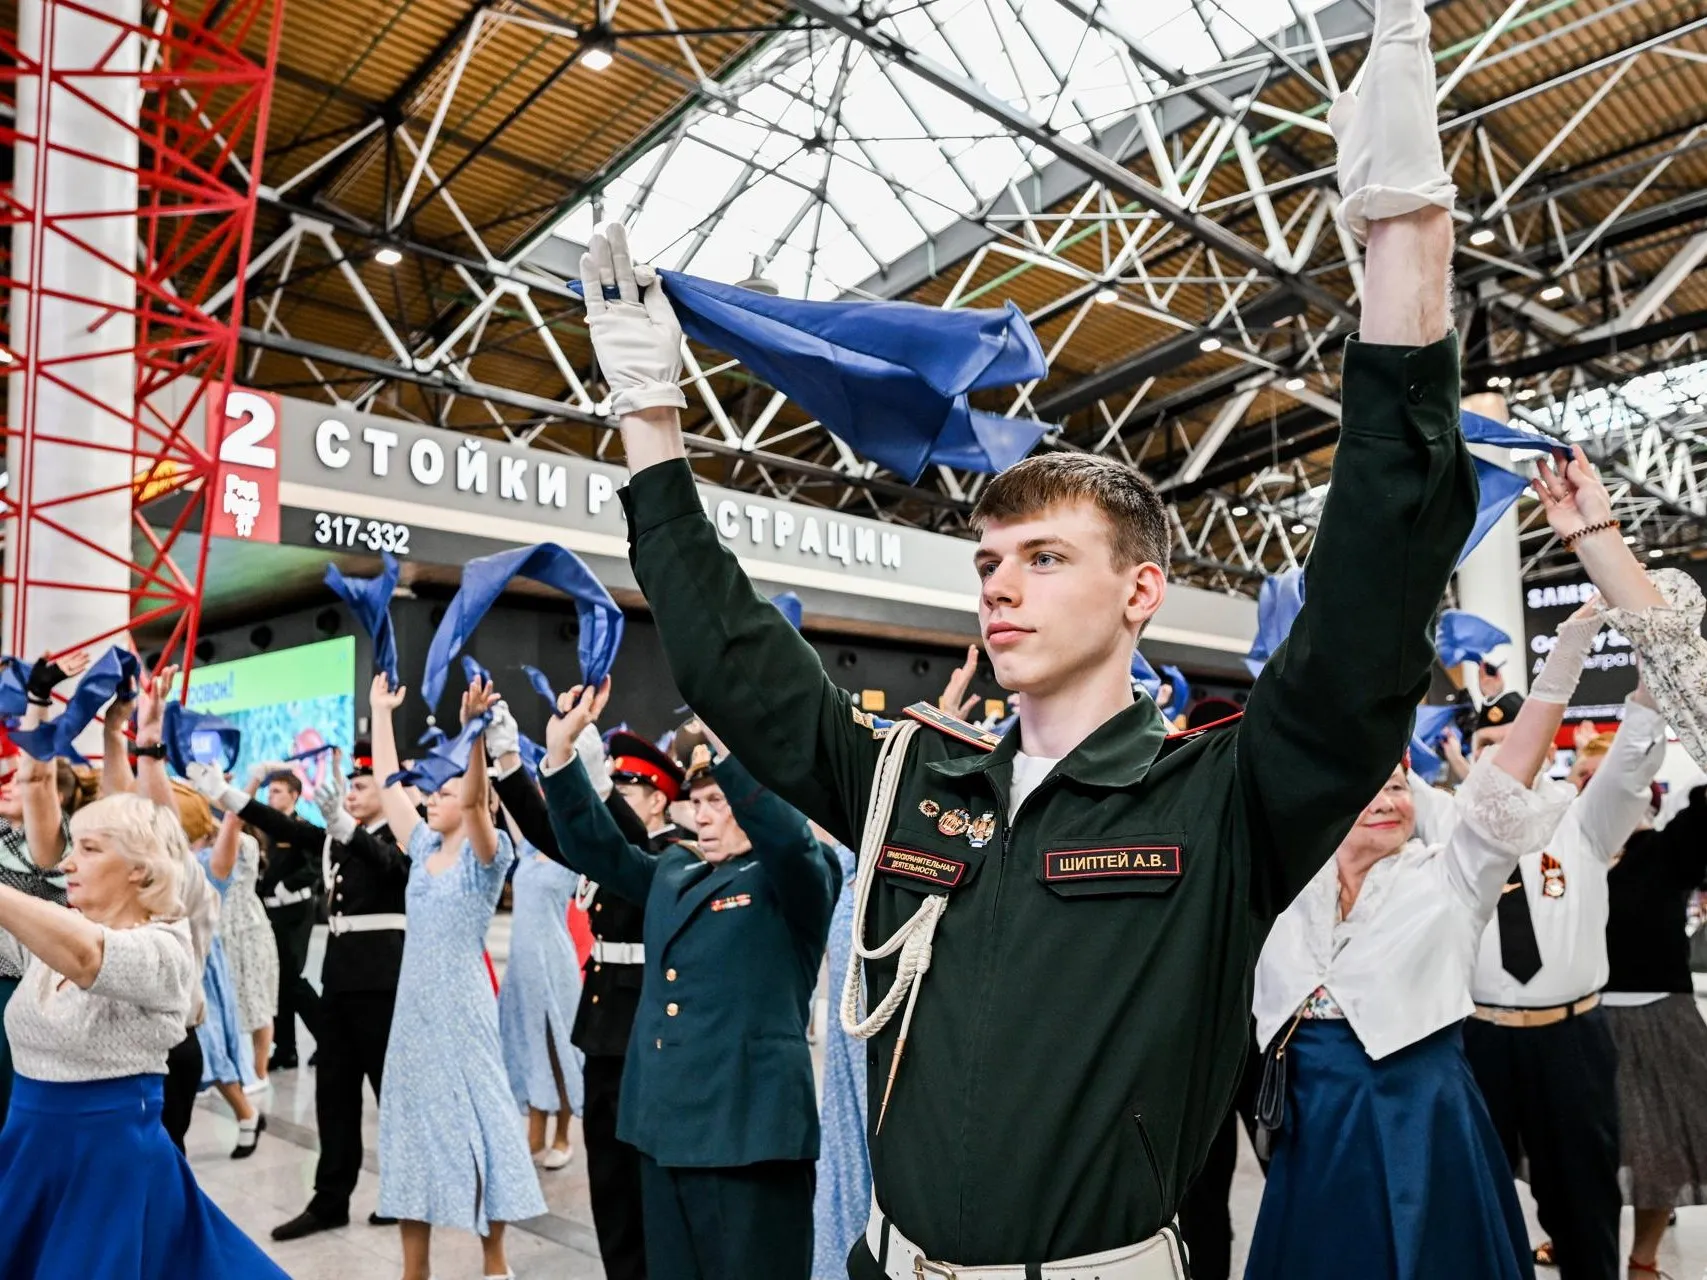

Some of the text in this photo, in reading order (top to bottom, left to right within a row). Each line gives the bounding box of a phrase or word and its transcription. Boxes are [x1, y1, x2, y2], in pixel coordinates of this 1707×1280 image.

[219, 391, 276, 469] 2
[315, 419, 567, 508] СТОЙКИ
[588, 472, 902, 568] РСТРАЦИИ
[314, 512, 410, 554] 317-332
[1527, 583, 1600, 608] SAMS
[891, 860, 938, 877] ДЕЯТЕЛЬНОСТЬ
[1059, 852, 1168, 872] ШИПТЕЙ А.В.
